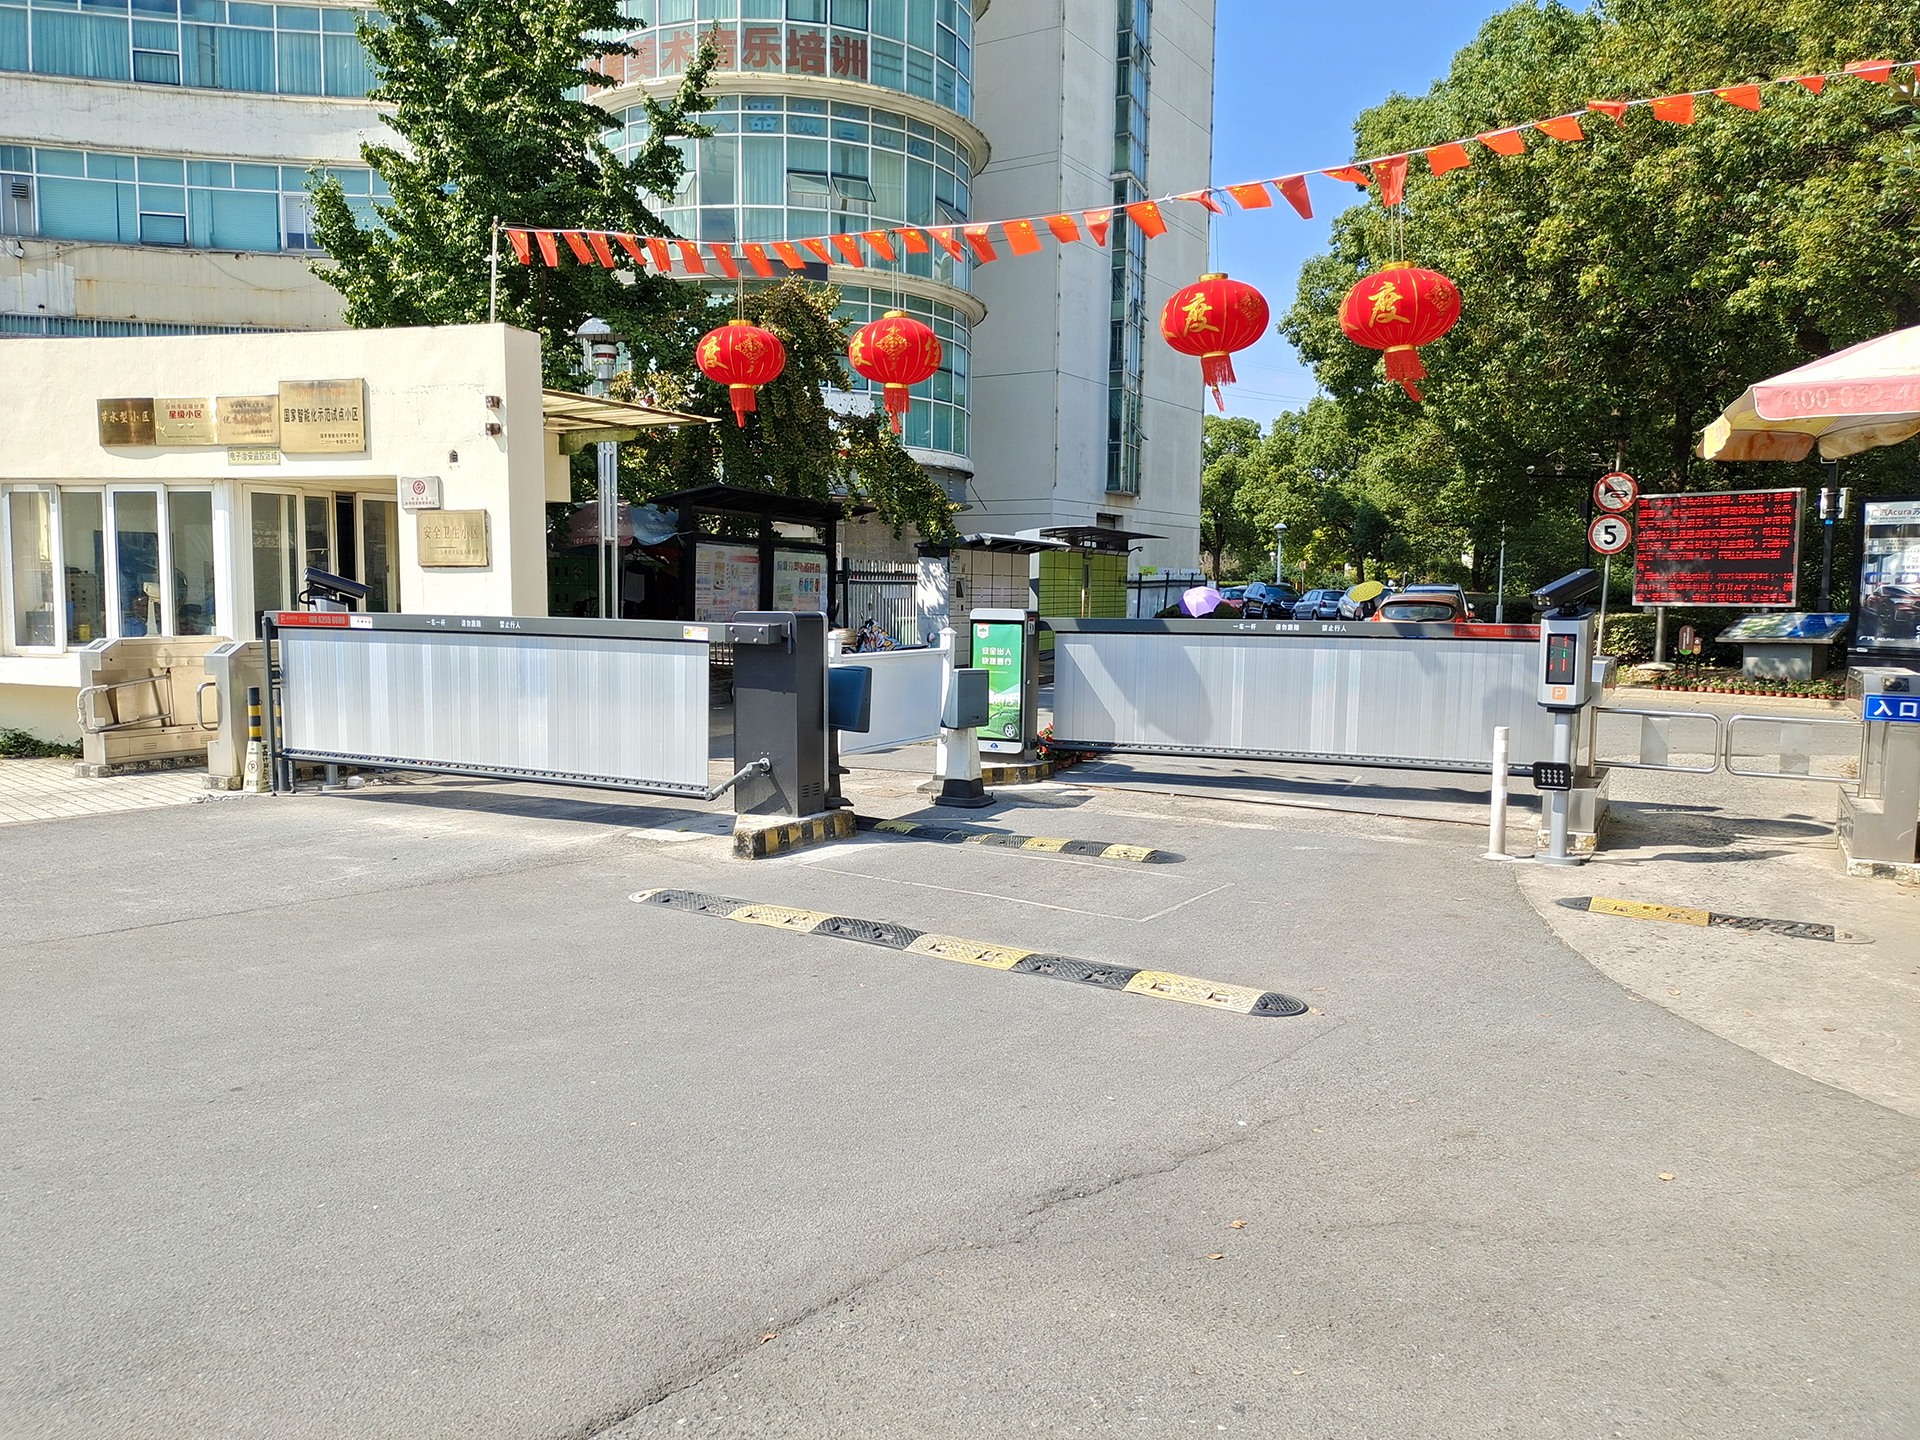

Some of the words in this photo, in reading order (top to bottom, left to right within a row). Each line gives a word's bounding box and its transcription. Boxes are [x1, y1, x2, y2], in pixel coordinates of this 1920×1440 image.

[101, 410, 150, 424] 节水型小区
[168, 410, 203, 420] 星级小区
[283, 407, 359, 424] 国家智能化示范试点小区
[230, 452, 278, 462] 电子治安监控区域
[423, 525, 479, 540] 安全卫生小区
[1603, 525, 1617, 545] 5
[499, 620, 521, 629] 禁止行人
[1232, 623, 1257, 631] 一车一杆
[1321, 624, 1347, 632] 禁止行人
[1503, 627, 1517, 636] 186
[1873, 699, 1918, 718] 入口
